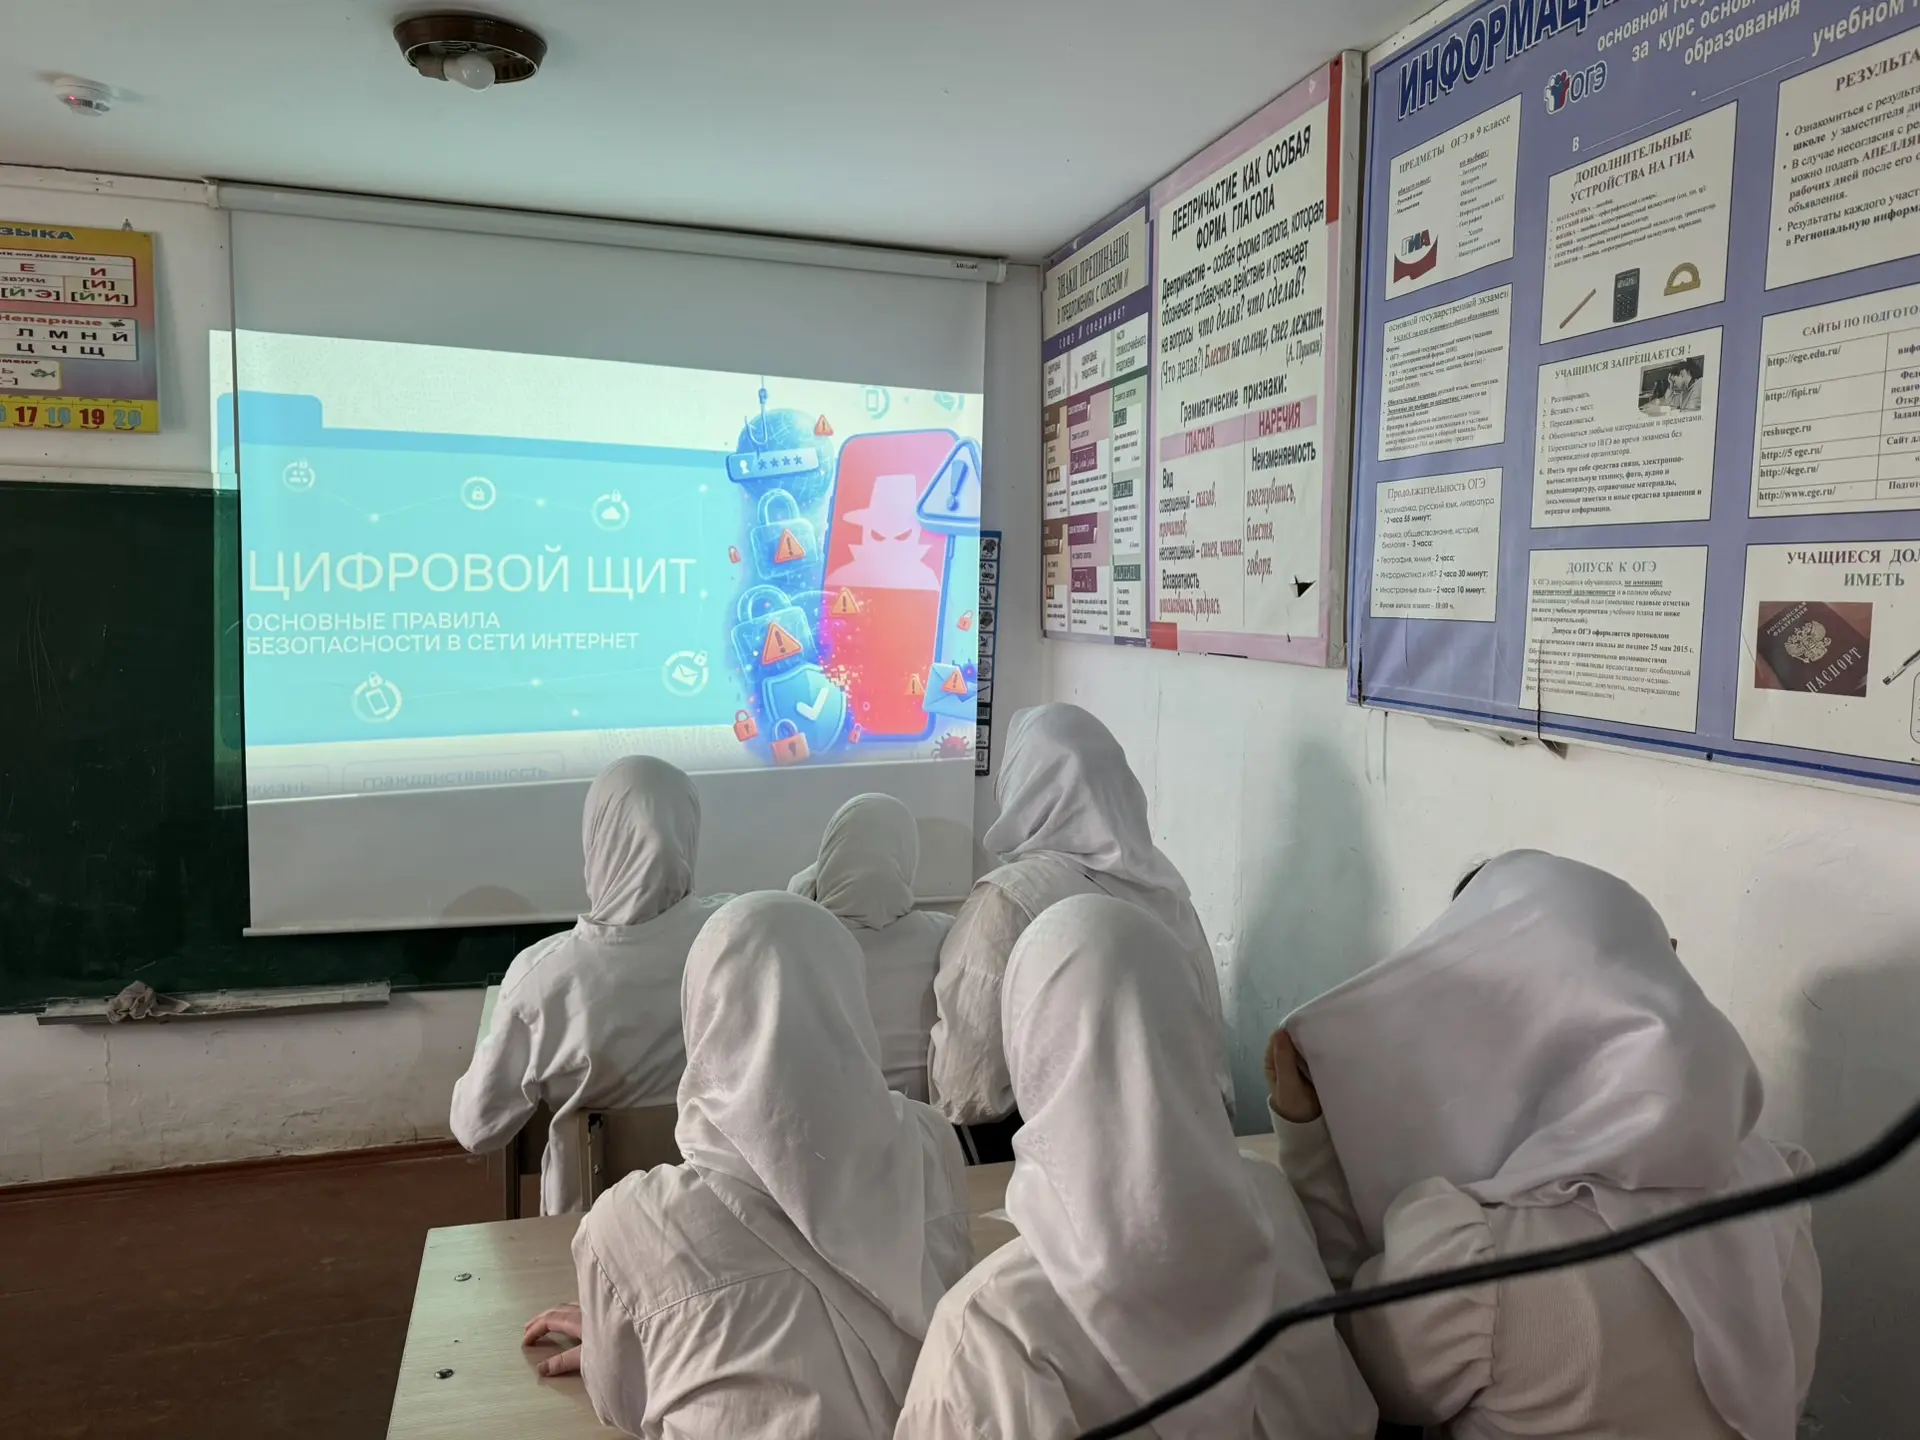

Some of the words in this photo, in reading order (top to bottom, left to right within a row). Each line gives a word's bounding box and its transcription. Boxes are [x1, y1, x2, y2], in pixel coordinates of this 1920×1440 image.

[1597, 0, 1668, 51] основной
[1632, 40, 1649, 62] за
[1659, 18, 1695, 51] курс
[1685, 0, 1800, 65] образования
[1812, 0, 1905, 57] учебном
[1398, 0, 1618, 122] ИНФОРМАЦ
[1836, 48, 1920, 91] РЕЗУЛЬТА
[1570, 61, 1607, 102] ОГЭ
[1794, 105, 1863, 136] Ознакомиться
[1867, 102, 1872, 110] с
[1875, 84, 1920, 110] результа
[1399, 144, 1444, 173] ПРЕДМЕТЫ
[1450, 133, 1468, 148] ОГЭ
[1470, 132, 1474, 140] в
[1477, 126, 1481, 136] 9
[1483, 115, 1510, 133] классе
[1793, 134, 1825, 151] школе
[1831, 130, 1837, 140] у
[1840, 106, 1904, 135] заместителя
[1574, 128, 1691, 184] ДОПОЛНИТЕЛЬНЫЕ
[1792, 158, 1798, 169] В
[1801, 148, 1834, 166] случае
[1837, 129, 1893, 154] несогласия
[1172, 172, 1237, 240] ДЕЕПРИЧАСТИЕ
[1242, 156, 1260, 192] КАК
[1266, 125, 1310, 177] ОСОБАЯ
[1571, 168, 1645, 204] УСТРОЙСТВА
[1648, 160, 1665, 175] НА
[1669, 149, 1694, 167] ГИА
[1789, 181, 1829, 201] рабочих
[1833, 170, 1858, 186] дней
[1862, 161, 1891, 177] после
[1894, 155, 1911, 167] его
[1791, 168, 1822, 184] можно
[1825, 157, 1859, 173] подать
[1196, 212, 1226, 251] ФОРМА
[1232, 184, 1274, 232] ГЛАГОЛА
[1787, 210, 1840, 232] Результаты
[1844, 198, 1885, 216] каждого
[1788, 191, 1847, 214] объявления.
[1401, 229, 1431, 256] ГИА
[1794, 218, 1869, 244] Региональную
[1080, 231, 1129, 287] ПРЕПИНАНИЯ
[1162, 263, 1205, 304] Деепричастие
[1213, 244, 1235, 274] особая
[1236, 234, 1260, 266] форма
[1291, 200, 1324, 233] которая
[0, 276, 46, 284] звуки
[20, 263, 36, 272] Е
[90, 267, 106, 277] И
[1162, 296, 1193, 326] обозначает
[1194, 278, 1231, 314] добавочное
[1232, 261, 1264, 297] действие
[1266, 258, 1271, 277] и
[1273, 240, 1308, 274] отвечает
[0, 314, 103, 326] Непарные
[1162, 336, 1168, 353] на
[1169, 326, 1193, 352] вопросы
[1198, 315, 1214, 338] что
[1216, 294, 1244, 331] делая?
[1247, 292, 1264, 317] что
[1267, 265, 1306, 309] сделав?
[1419, 297, 1476, 323] государственный
[1478, 290, 1508, 305] экзамен
[1802, 320, 1840, 336] САЙТЫ
[1844, 317, 1859, 328] ПО
[1863, 305, 1920, 324] ПОДГОТО
[16, 328, 34, 338] Л
[49, 330, 68, 340] М
[80, 331, 97, 341] Н
[112, 331, 128, 343] Й
[16, 343, 34, 354] Ц
[51, 345, 67, 354] Ч
[80, 346, 105, 357] Щ
[1160, 360, 1175, 390] (Что
[1177, 346, 1203, 382] делая?)
[1204, 342, 1230, 368] Блестя
[1231, 338, 1239, 358] на
[1241, 328, 1268, 355] солнце,
[1271, 319, 1288, 344] снег
[1290, 307, 1324, 337] лежит.
[1555, 361, 1608, 379] УЧАЩИМСЯ
[1611, 346, 1684, 368] ЗАПРЕЩАЕТСЯ
[1767, 346, 1841, 366] http://ege.edu.ru/
[1180, 389, 1238, 426] Грамматические
[1243, 374, 1287, 408] признаки:
[1765, 386, 1821, 402] http://fipi.ru/
[15, 406, 38, 423] 17
[79, 408, 105, 425] 19
[113, 410, 141, 427] 20
[1185, 425, 1215, 454] ГЛАГОЛА
[1258, 401, 1301, 436] НАРЕЧИЯ
[1763, 425, 1811, 437] reshuege.ru
[1761, 448, 1792, 460] http://5
[1794, 445, 1822, 458] ege.ru/
[1886, 436, 1908, 445] Сайт
[1162, 468, 1173, 489] Вид
[1252, 442, 1316, 471] Неизменяемость
[1759, 464, 1819, 479] http://4ege.ru/
[1159, 490, 1190, 514] совершенный
[1387, 483, 1465, 501] Продолжительность
[1467, 477, 1485, 490] ОГЭ
[1758, 486, 1835, 502] http://www.ege.ru/
[1419, 501, 1444, 511] русский
[1246, 517, 1274, 542] блестя,
[249, 544, 569, 601] ЦИФРОВОЙ
[587, 554, 697, 601] ЩИТ
[1246, 549, 1272, 583] говоря.
[1566, 562, 1613, 574] ДОПУСК
[1619, 562, 1626, 571] К
[1632, 561, 1656, 572] ОГЭ
[1788, 550, 1880, 565] УЧАЩИЕСЯ
[1162, 569, 1199, 596] Возвратность
[1844, 573, 1904, 586] ИМЕТЬ
[246, 611, 386, 632] ОСНОВНЫЕ
[392, 611, 501, 631] ПРАВИЛА
[1766, 601, 1808, 636] РОССИЙСКАЯ
[1773, 607, 1809, 637] ФЕДЕРАЦИЯ
[246, 633, 441, 656] БЕЗОПАСНОСТИ
[445, 635, 462, 651] В
[467, 633, 526, 651] СЕТИ
[531, 632, 640, 651] ИНТЕРНЕТ
[1650, 643, 1657, 651] 25
[1805, 646, 1862, 693] ПАСПОРТ
